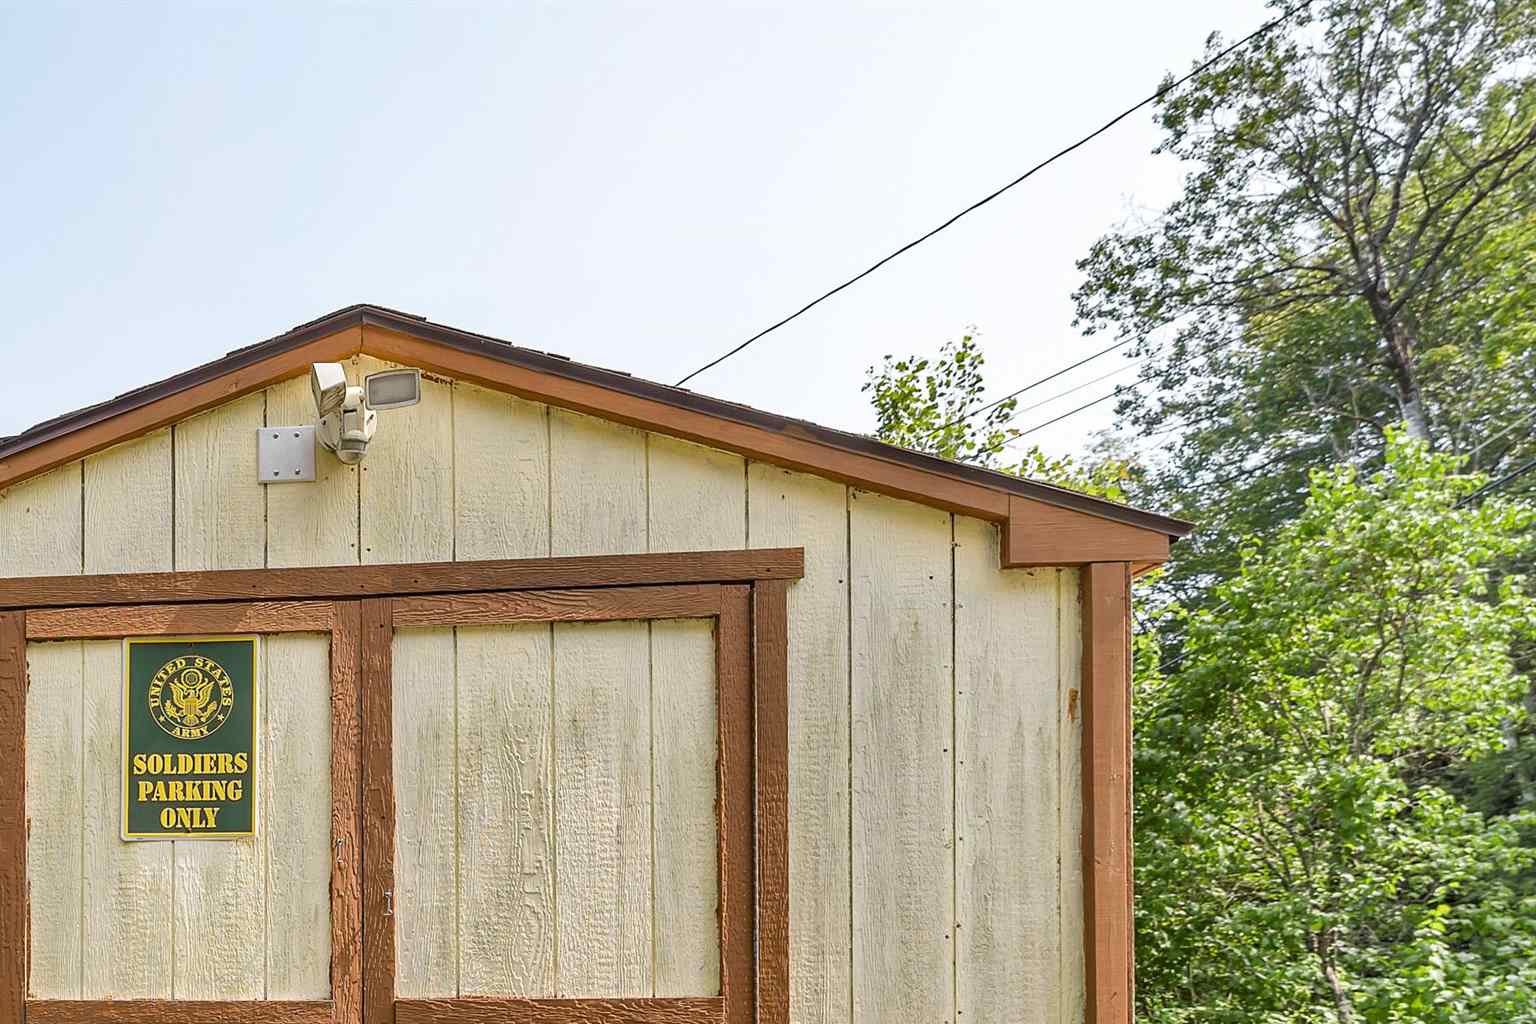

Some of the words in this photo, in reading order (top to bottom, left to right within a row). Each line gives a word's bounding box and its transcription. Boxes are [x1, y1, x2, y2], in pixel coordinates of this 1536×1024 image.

[150, 657, 187, 709] UNITED
[193, 656, 233, 708] STATES
[171, 725, 209, 738] ARMY
[133, 752, 248, 775] SOLDIERS
[137, 779, 243, 801] PARKING
[160, 807, 221, 828] ONLY
